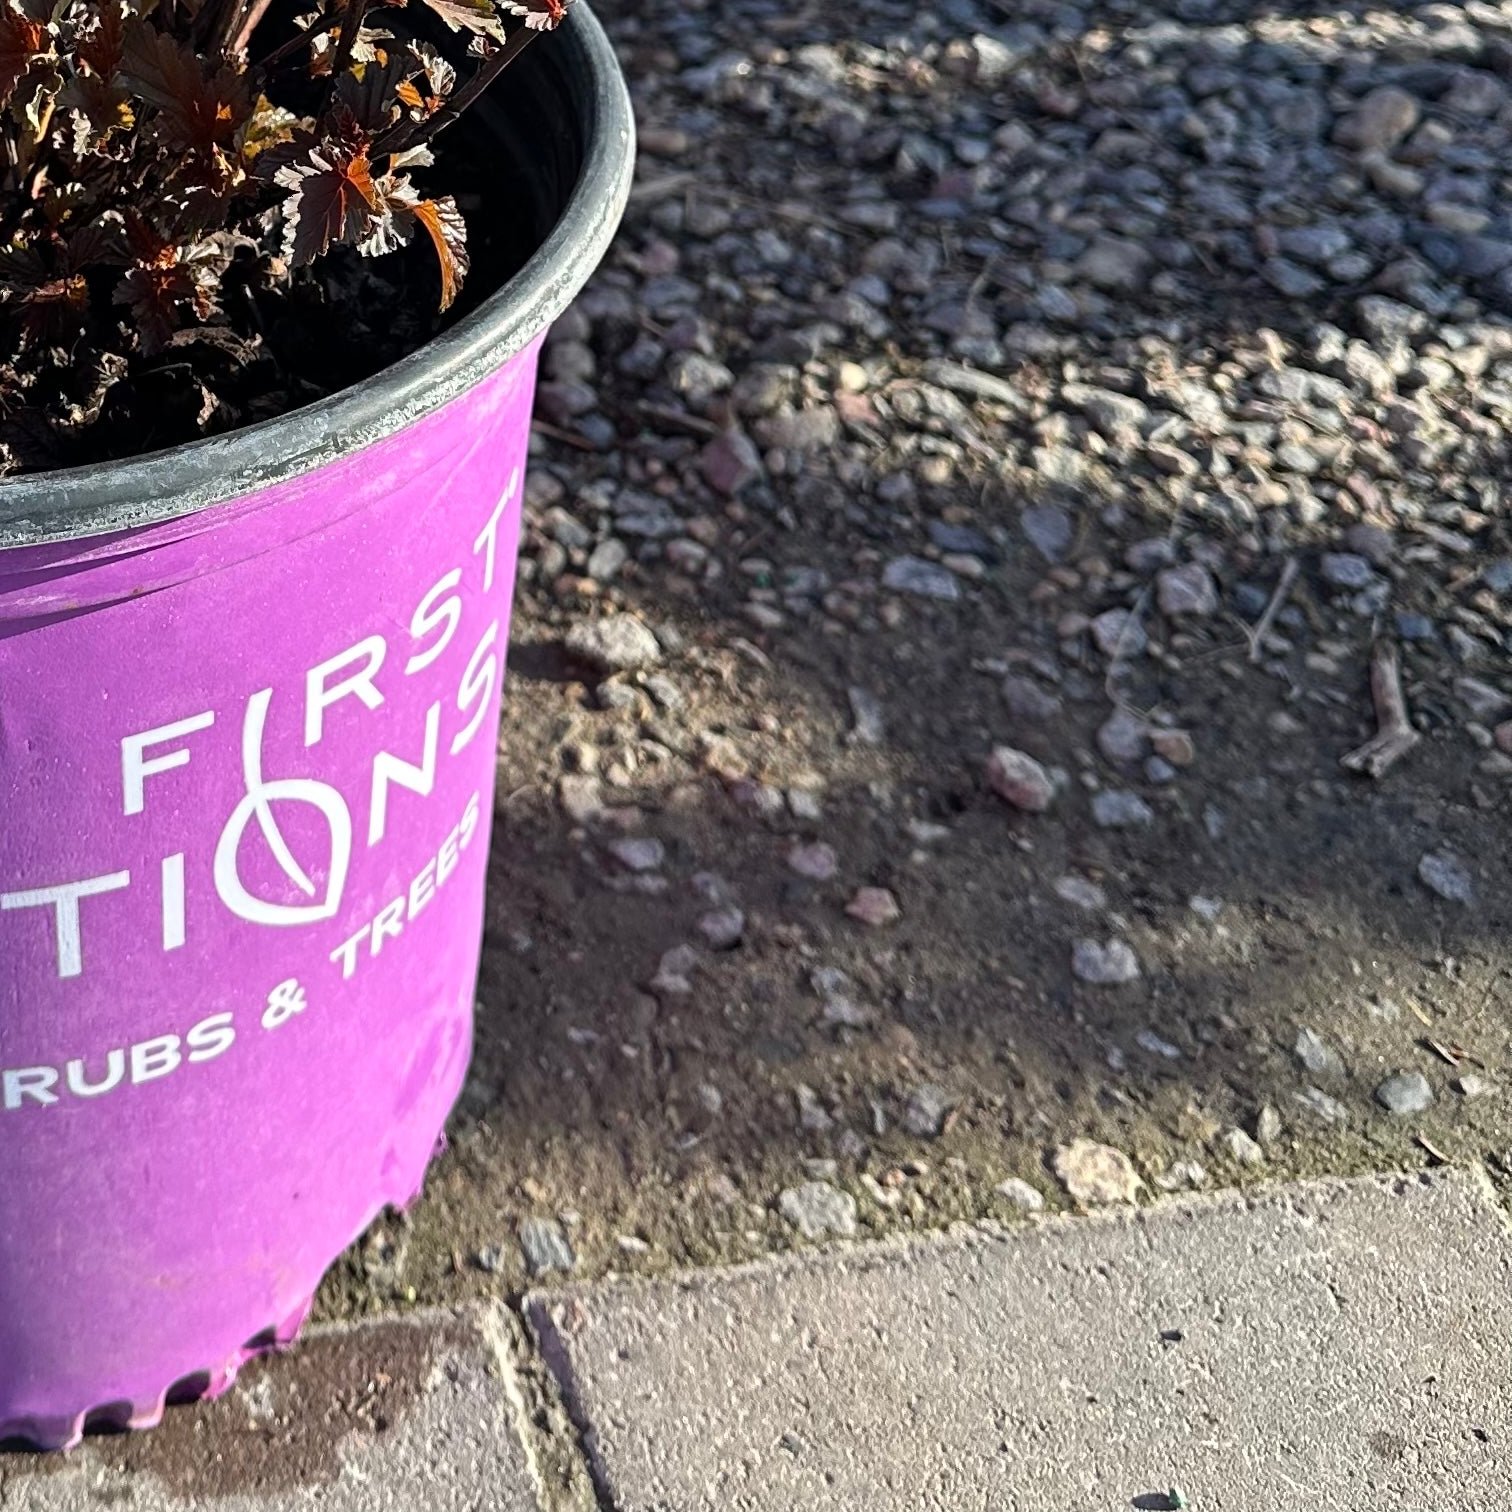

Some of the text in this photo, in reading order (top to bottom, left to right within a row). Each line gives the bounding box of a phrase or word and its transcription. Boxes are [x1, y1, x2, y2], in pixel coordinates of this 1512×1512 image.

[121, 466, 518, 818] FIRST
[261, 978, 307, 1030] &
[330, 790, 480, 979] TREES
